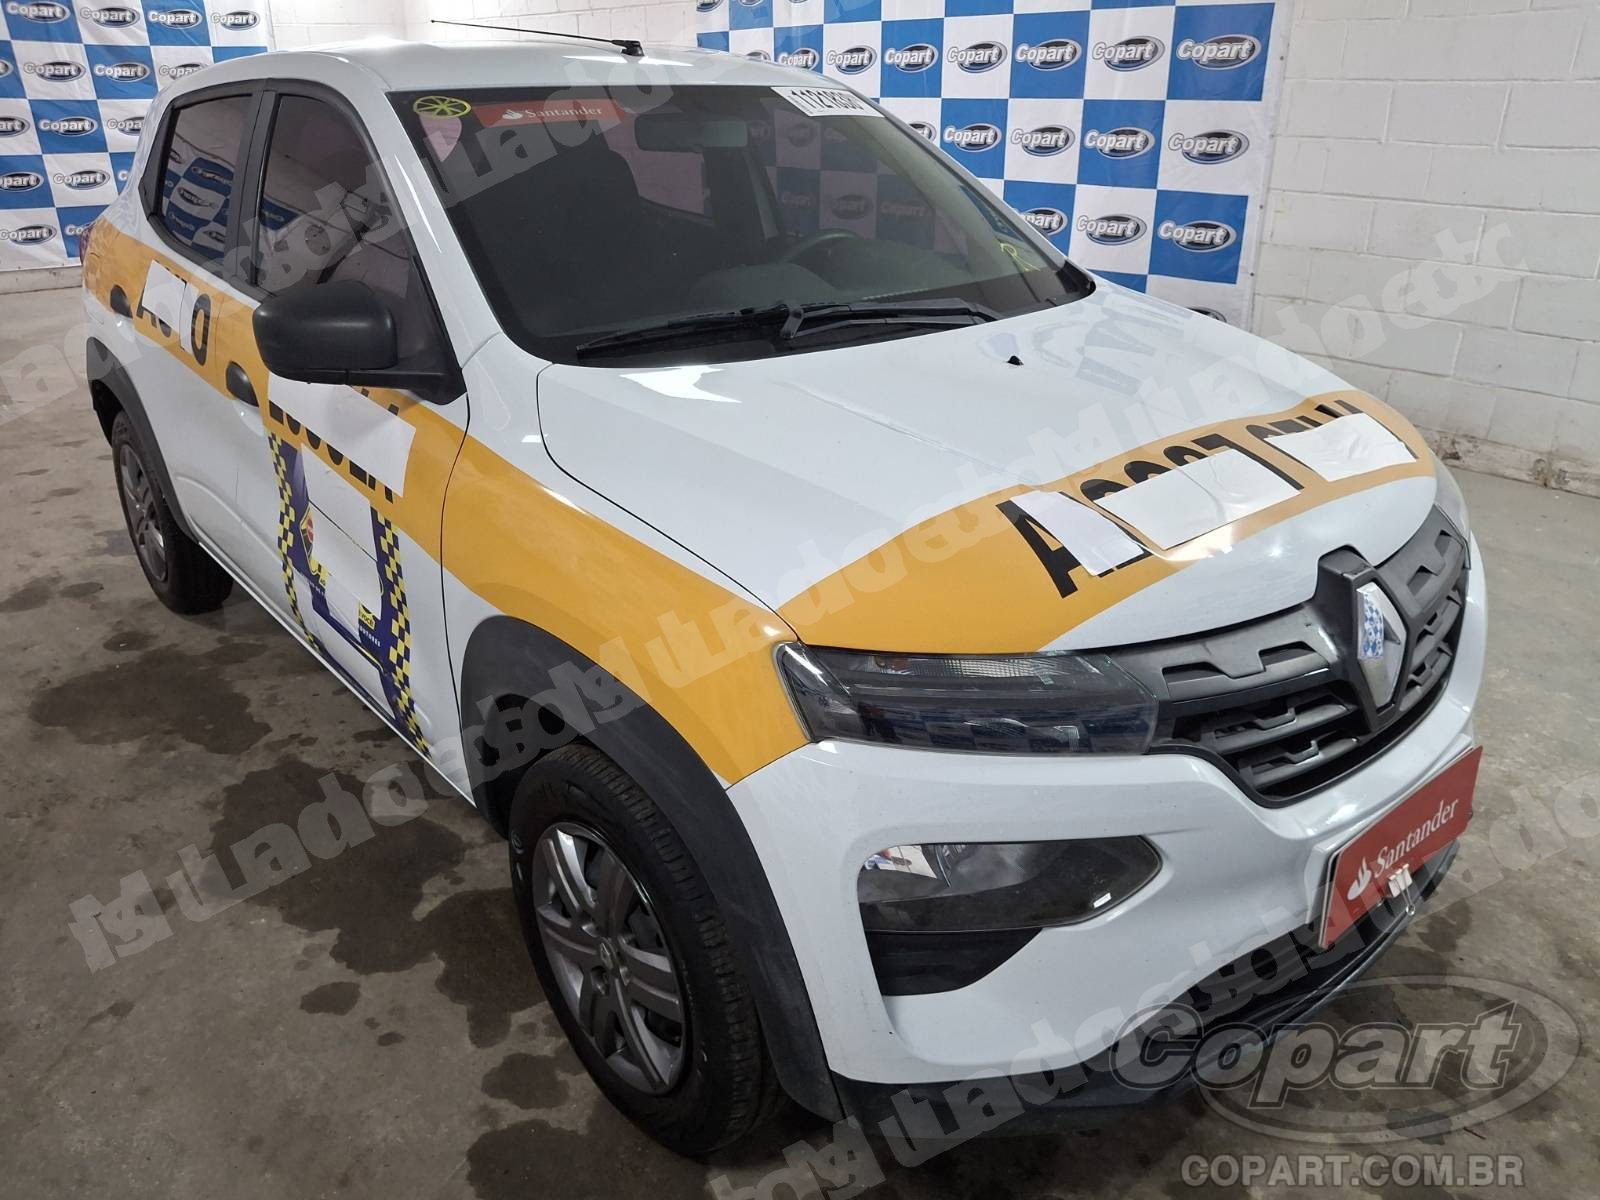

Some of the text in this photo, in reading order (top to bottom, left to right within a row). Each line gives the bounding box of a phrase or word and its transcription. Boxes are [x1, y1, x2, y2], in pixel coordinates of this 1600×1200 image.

[7, 2, 63, 18] Copart
[81, 7, 132, 23] Copart
[148, 10, 197, 25] Copart
[211, 12, 254, 27] Copart
[827, 49, 870, 69] Copart
[884, 47, 932, 68] Copart
[947, 45, 999, 66] Copart
[1015, 42, 1074, 66] Copart
[1092, 41, 1153, 65] Copart
[1176, 38, 1251, 63] Copart
[23, 62, 77, 77] Copart
[95, 64, 144, 78] Copart
[525, 106, 602, 118] Santander
[0, 120, 21, 130] art
[40, 119, 90, 133] Copart
[107, 119, 143, 132] Copa
[943, 126, 995, 148] Copart
[1010, 125, 1068, 151] Copart
[1084, 130, 1148, 154] Copart
[1168, 133, 1239, 157] Copart
[53, 173, 103, 187] Copart
[0, 226, 50, 240] Copart
[1077, 216, 1139, 240] Copart
[1158, 221, 1228, 245] Copart
[1374, 799, 1458, 878] Santander
